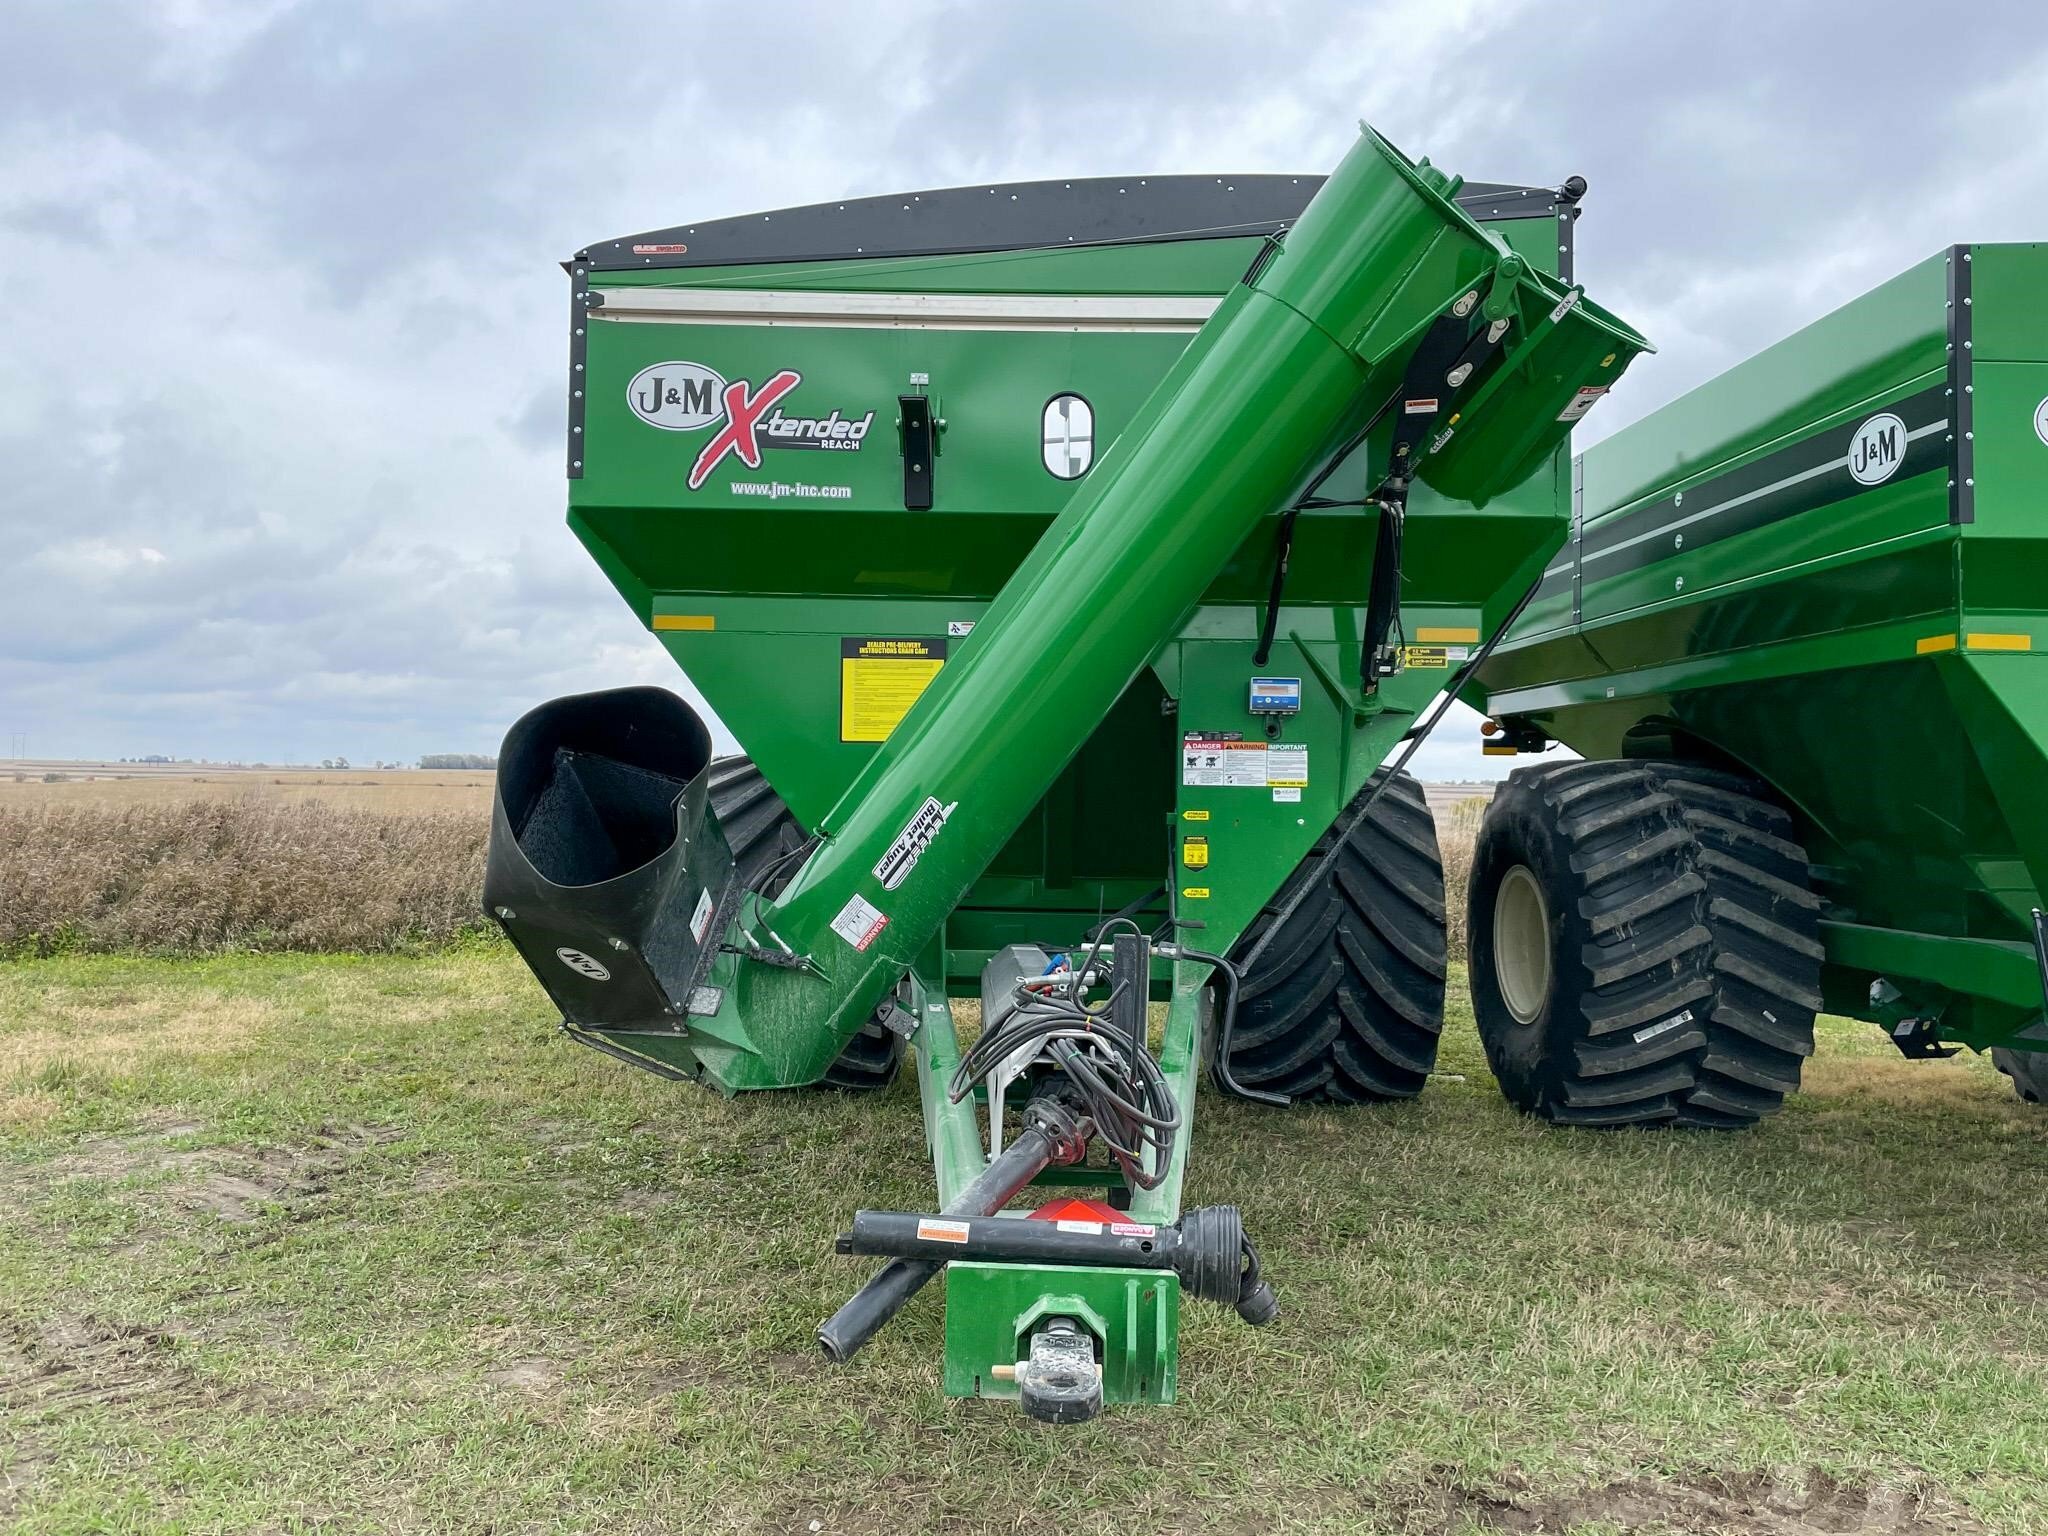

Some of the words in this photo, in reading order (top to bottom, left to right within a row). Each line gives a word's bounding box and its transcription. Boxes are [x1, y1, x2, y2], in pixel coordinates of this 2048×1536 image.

[1555, 299, 1572, 318] OPEN
[638, 377, 715, 415] J&M
[821, 440, 860, 450] REACH
[1432, 429, 1451, 451] CLOSED
[1854, 425, 1897, 474] J&M
[730, 482, 851, 498] www.jm-inc.com
[907, 803, 935, 840] Bullet
[879, 839, 906, 877] Auger
[857, 920, 884, 951] DANGER
[562, 952, 606, 977] J&M
[1113, 1225, 1143, 1234] DANGER
